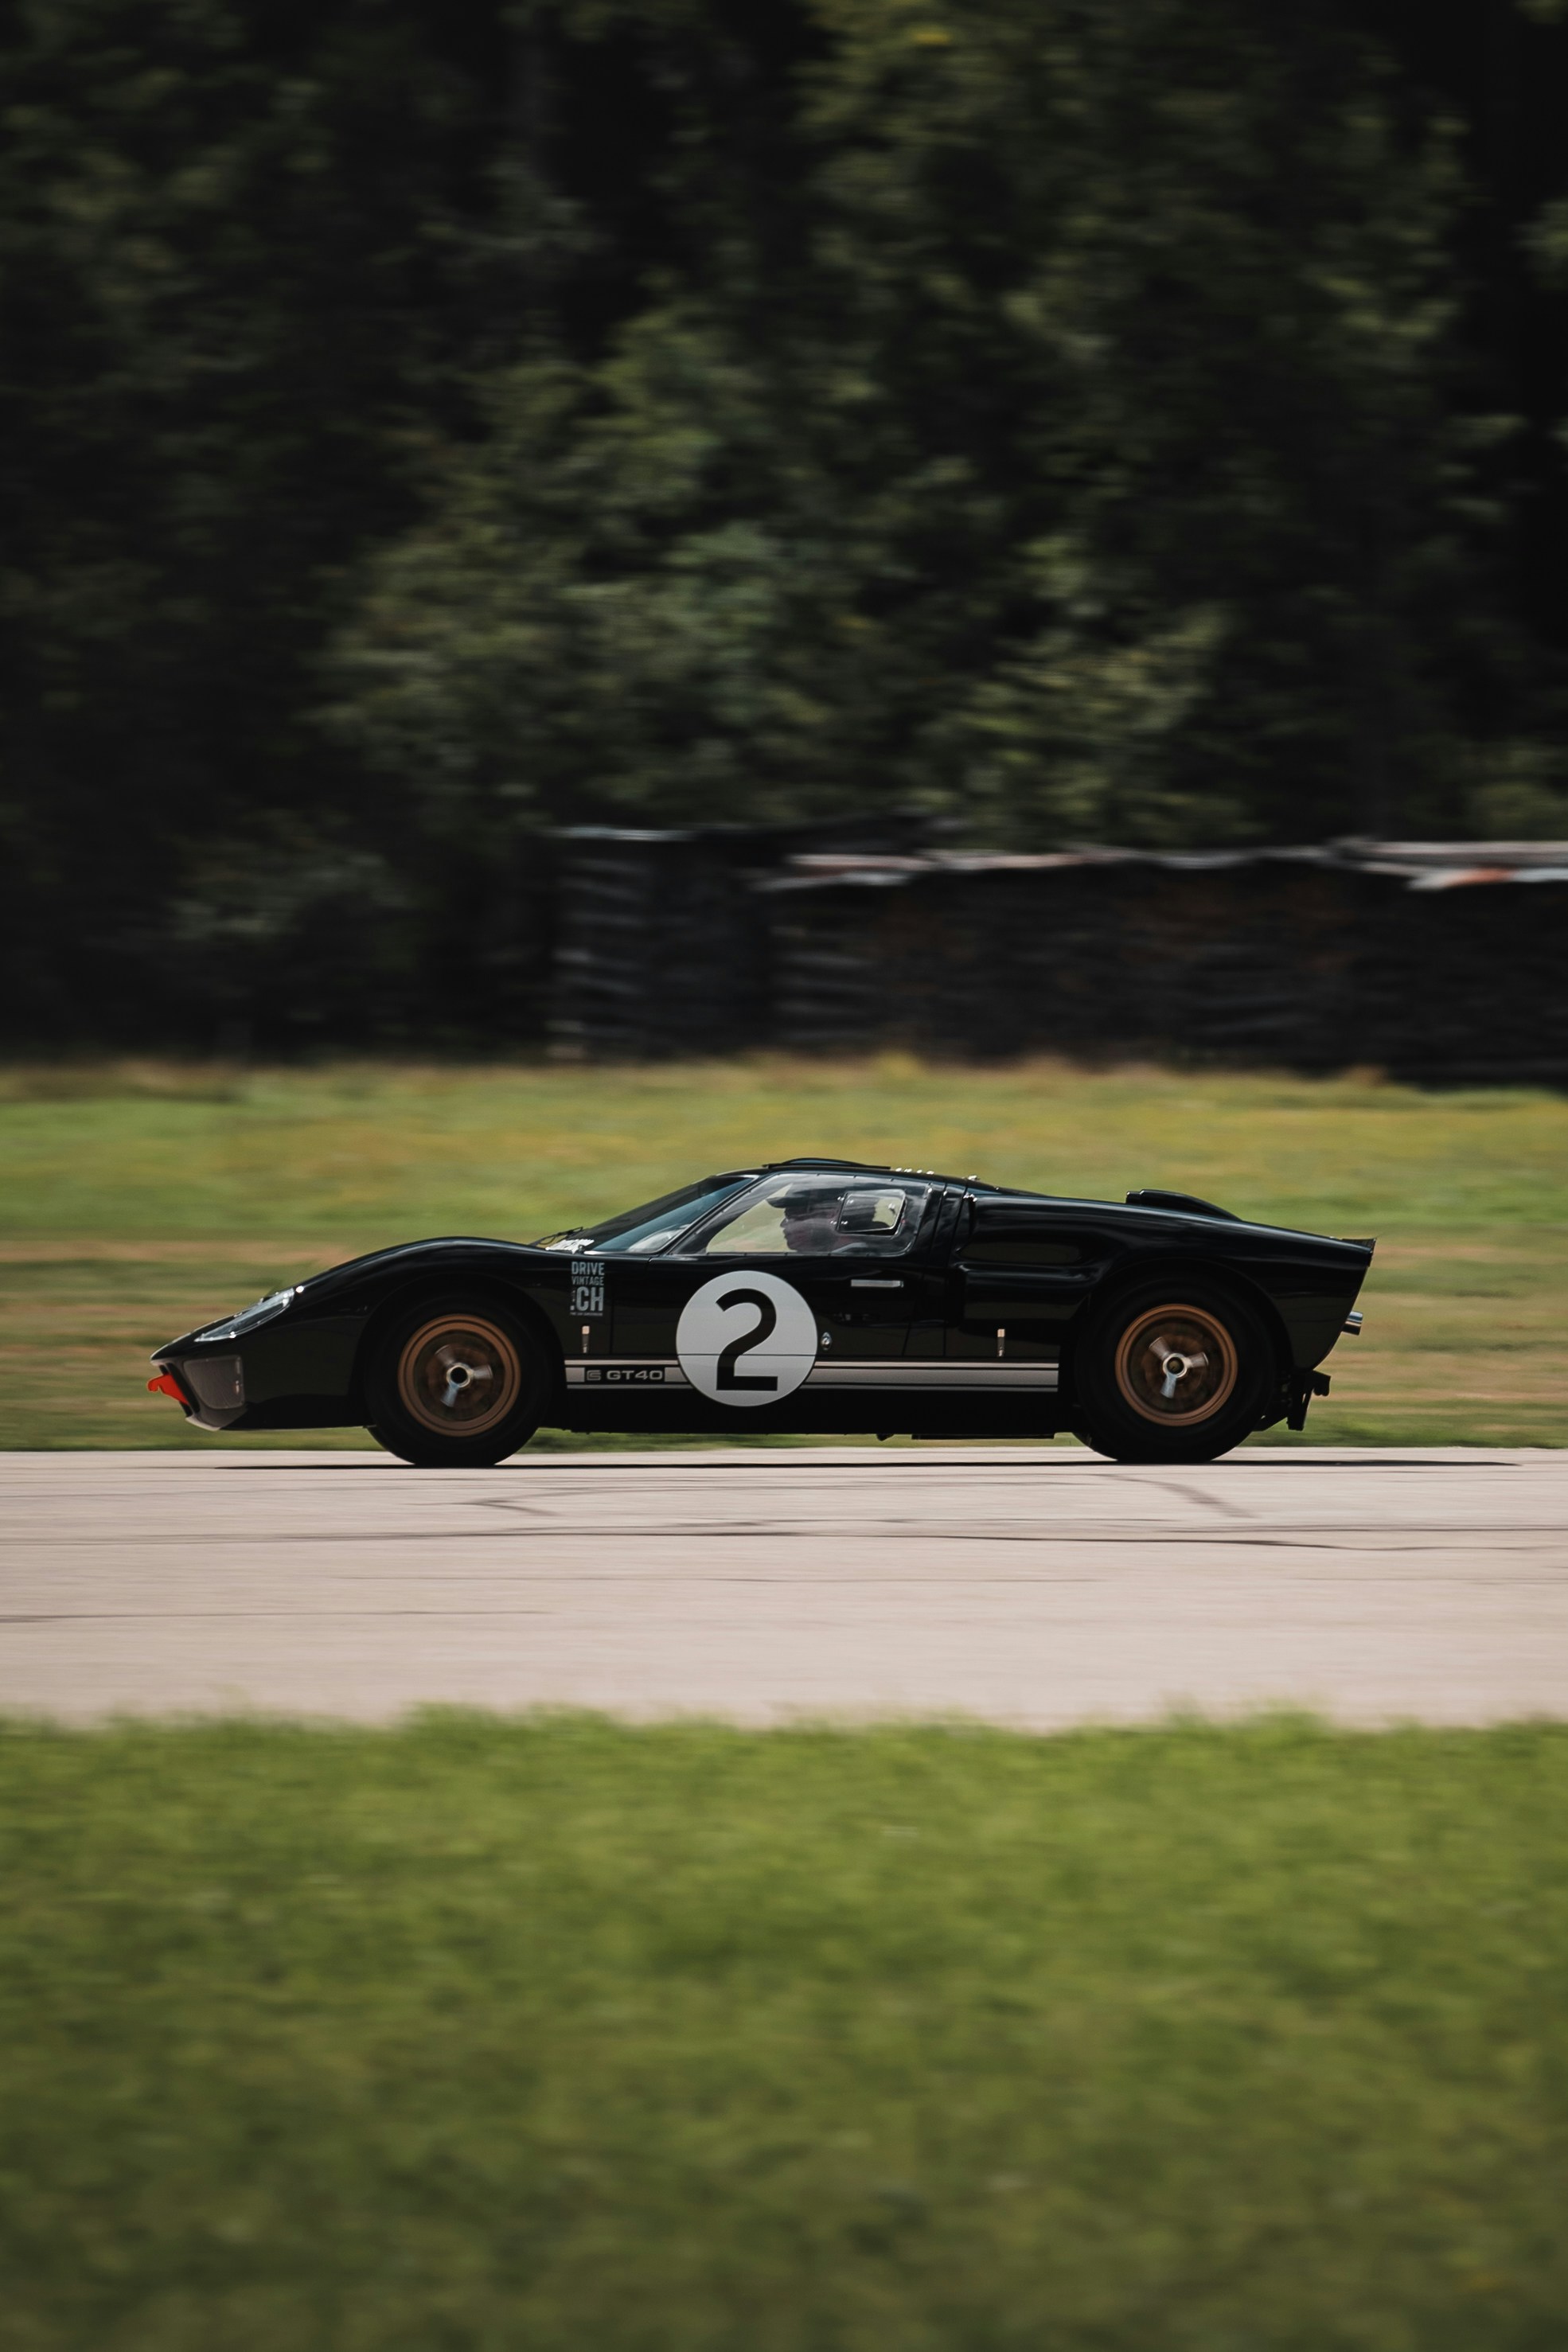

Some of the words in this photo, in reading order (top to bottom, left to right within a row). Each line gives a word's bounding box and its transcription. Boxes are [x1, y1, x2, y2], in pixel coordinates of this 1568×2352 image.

[571, 1262, 605, 1275] DRIVE
[571, 1276, 604, 1285] VINTAGE
[570, 1286, 604, 1311] .CH
[716, 1288, 778, 1391] 2
[607, 1370, 663, 1380] GT40
